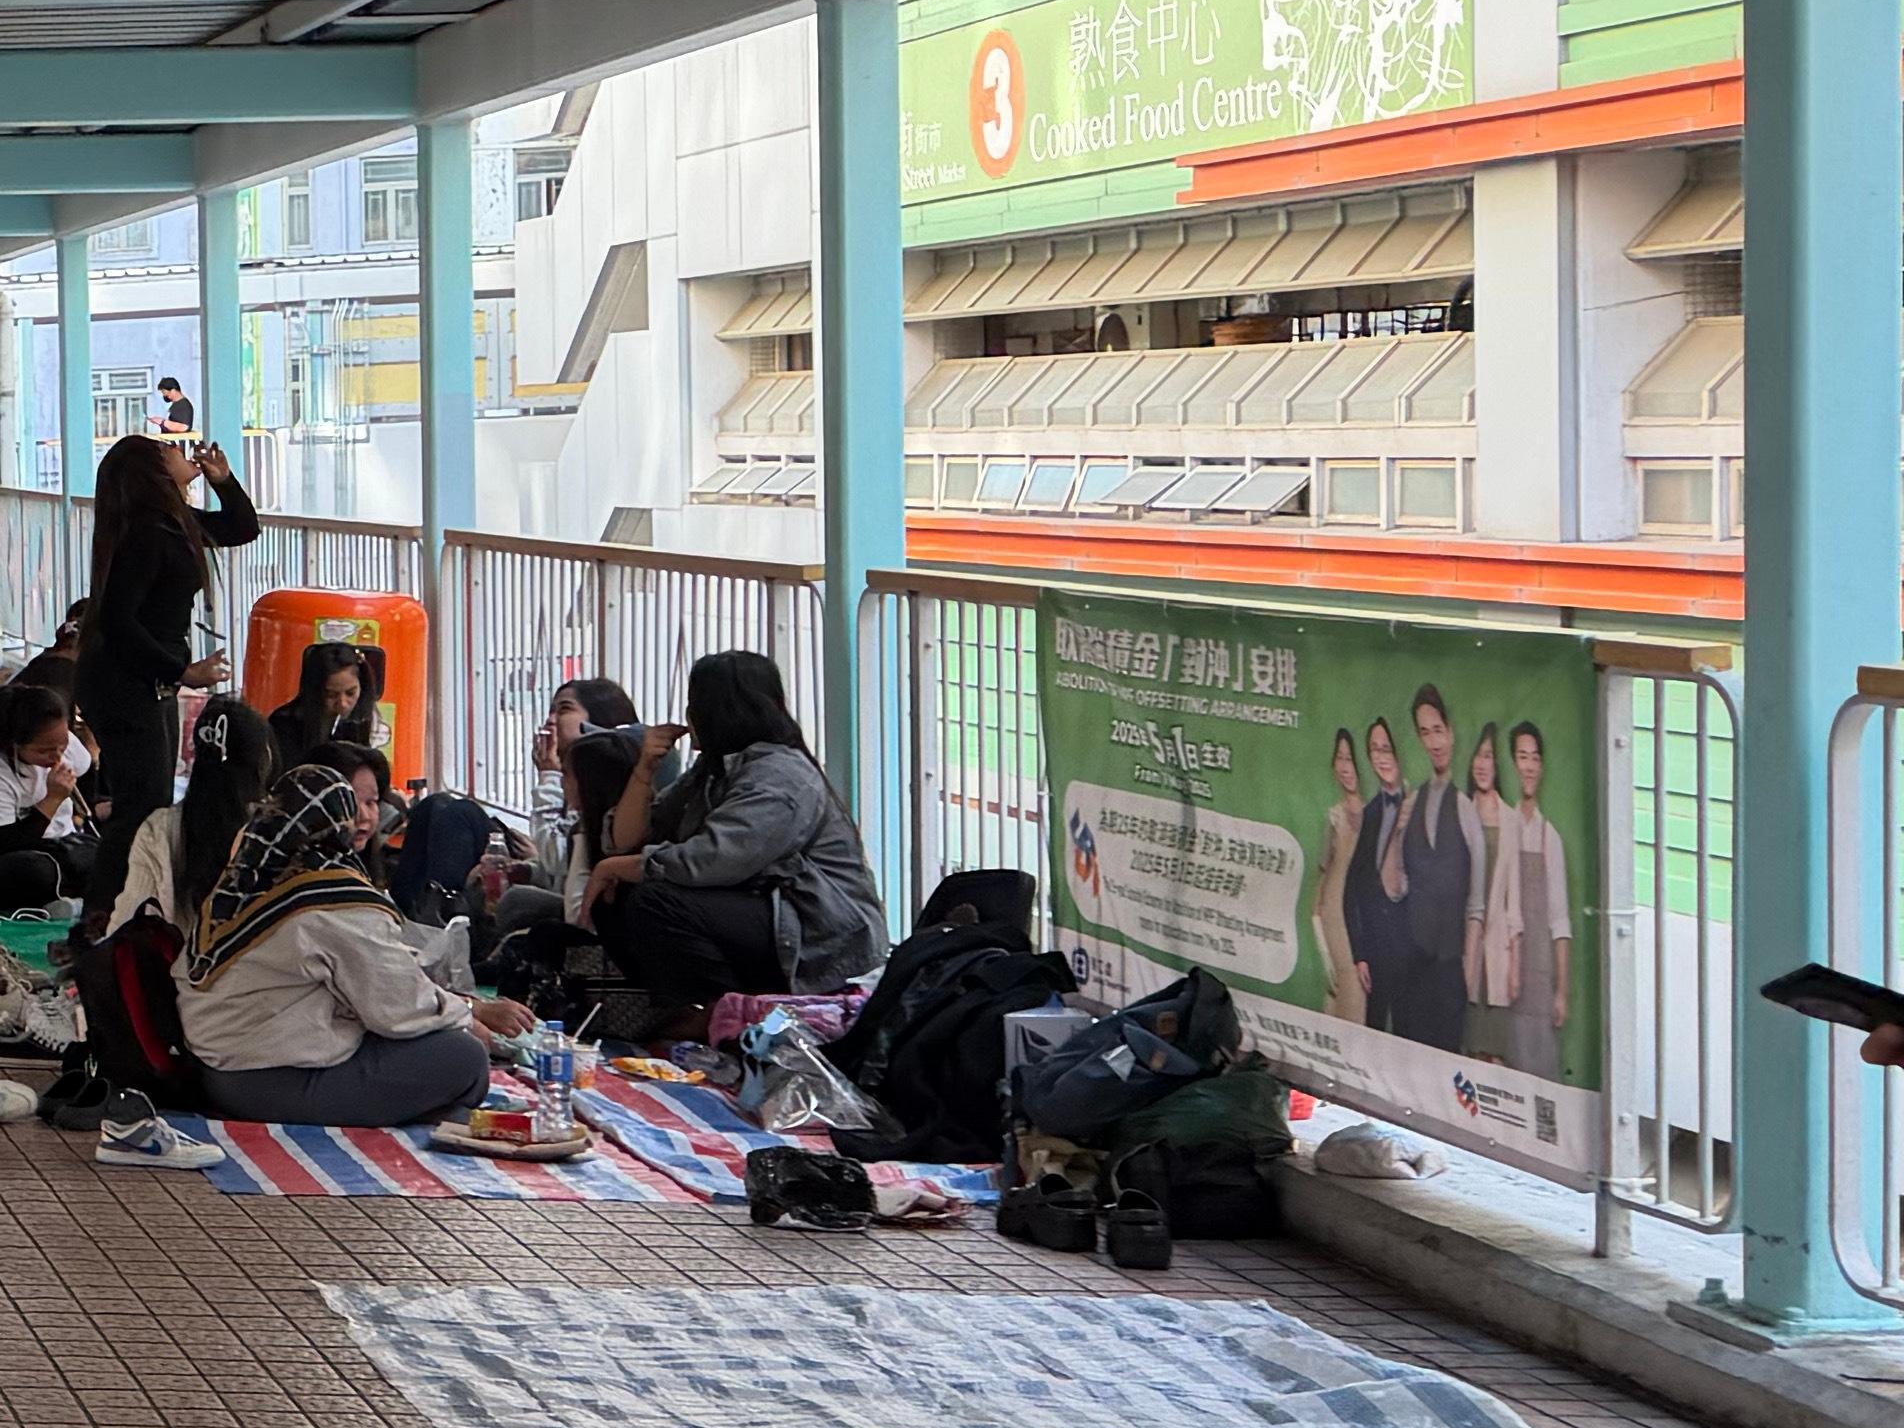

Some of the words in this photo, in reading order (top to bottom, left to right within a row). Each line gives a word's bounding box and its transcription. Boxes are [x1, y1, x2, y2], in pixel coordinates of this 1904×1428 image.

[982, 47, 1014, 160] 3
[1028, 94, 1117, 164] Cooked
[1122, 79, 1186, 146] Food
[1192, 75, 1283, 133] Centre
[1136, 689, 1210, 715] OFFSETTING
[1209, 699, 1300, 729] ARRANGEMENT
